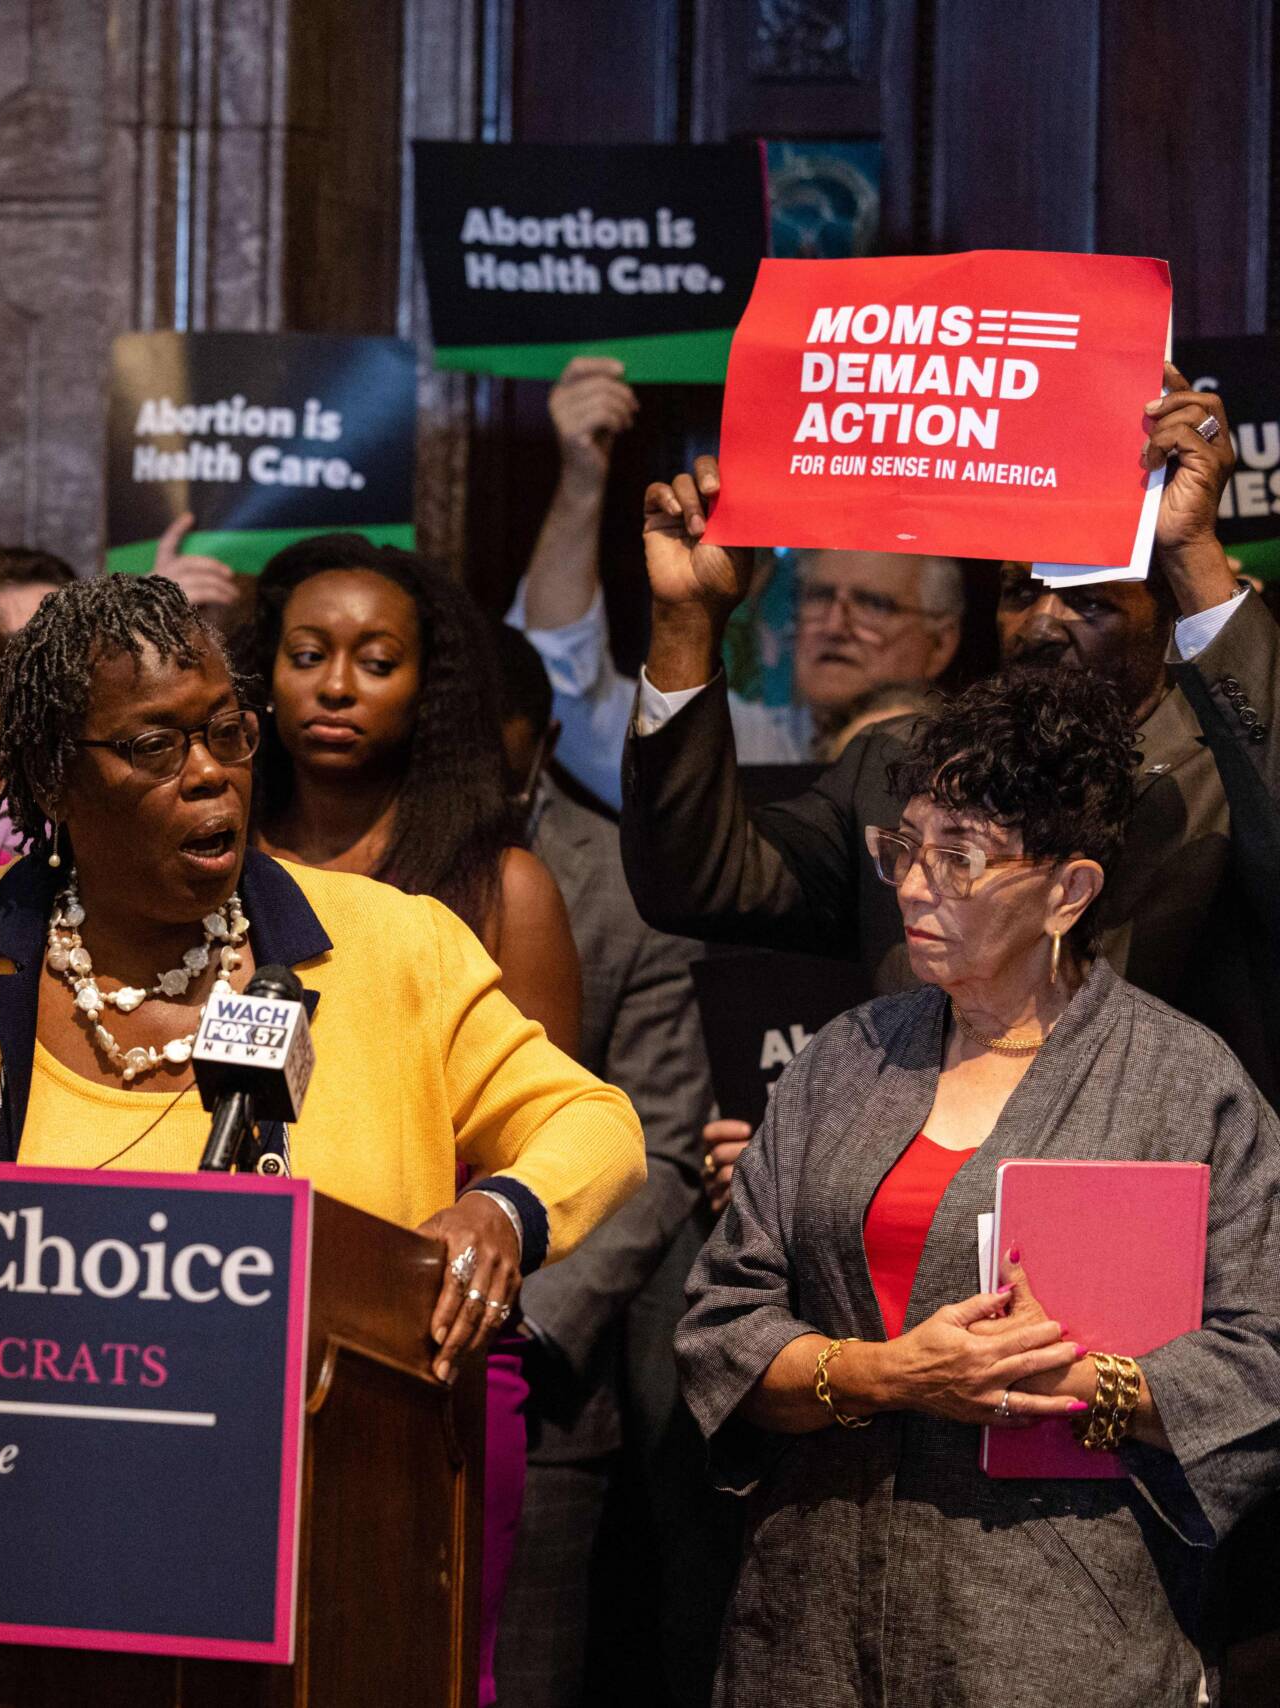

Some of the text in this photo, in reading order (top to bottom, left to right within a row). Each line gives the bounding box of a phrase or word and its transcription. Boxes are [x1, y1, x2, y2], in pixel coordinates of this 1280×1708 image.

[460, 207, 695, 249] Abortion is
[464, 252, 725, 294] Health Care.
[806, 304, 974, 346] MOMS
[800, 352, 1039, 400] DEMAND
[134, 394, 343, 441] Abortion is
[793, 402, 1000, 450] ACTION
[131, 442, 366, 490] Health Care.
[790, 455, 1058, 488] FOR GUN SENSE IN AMERICA
[206, 1020, 284, 1047] FOX 57
[218, 1000, 289, 1025] WACH
